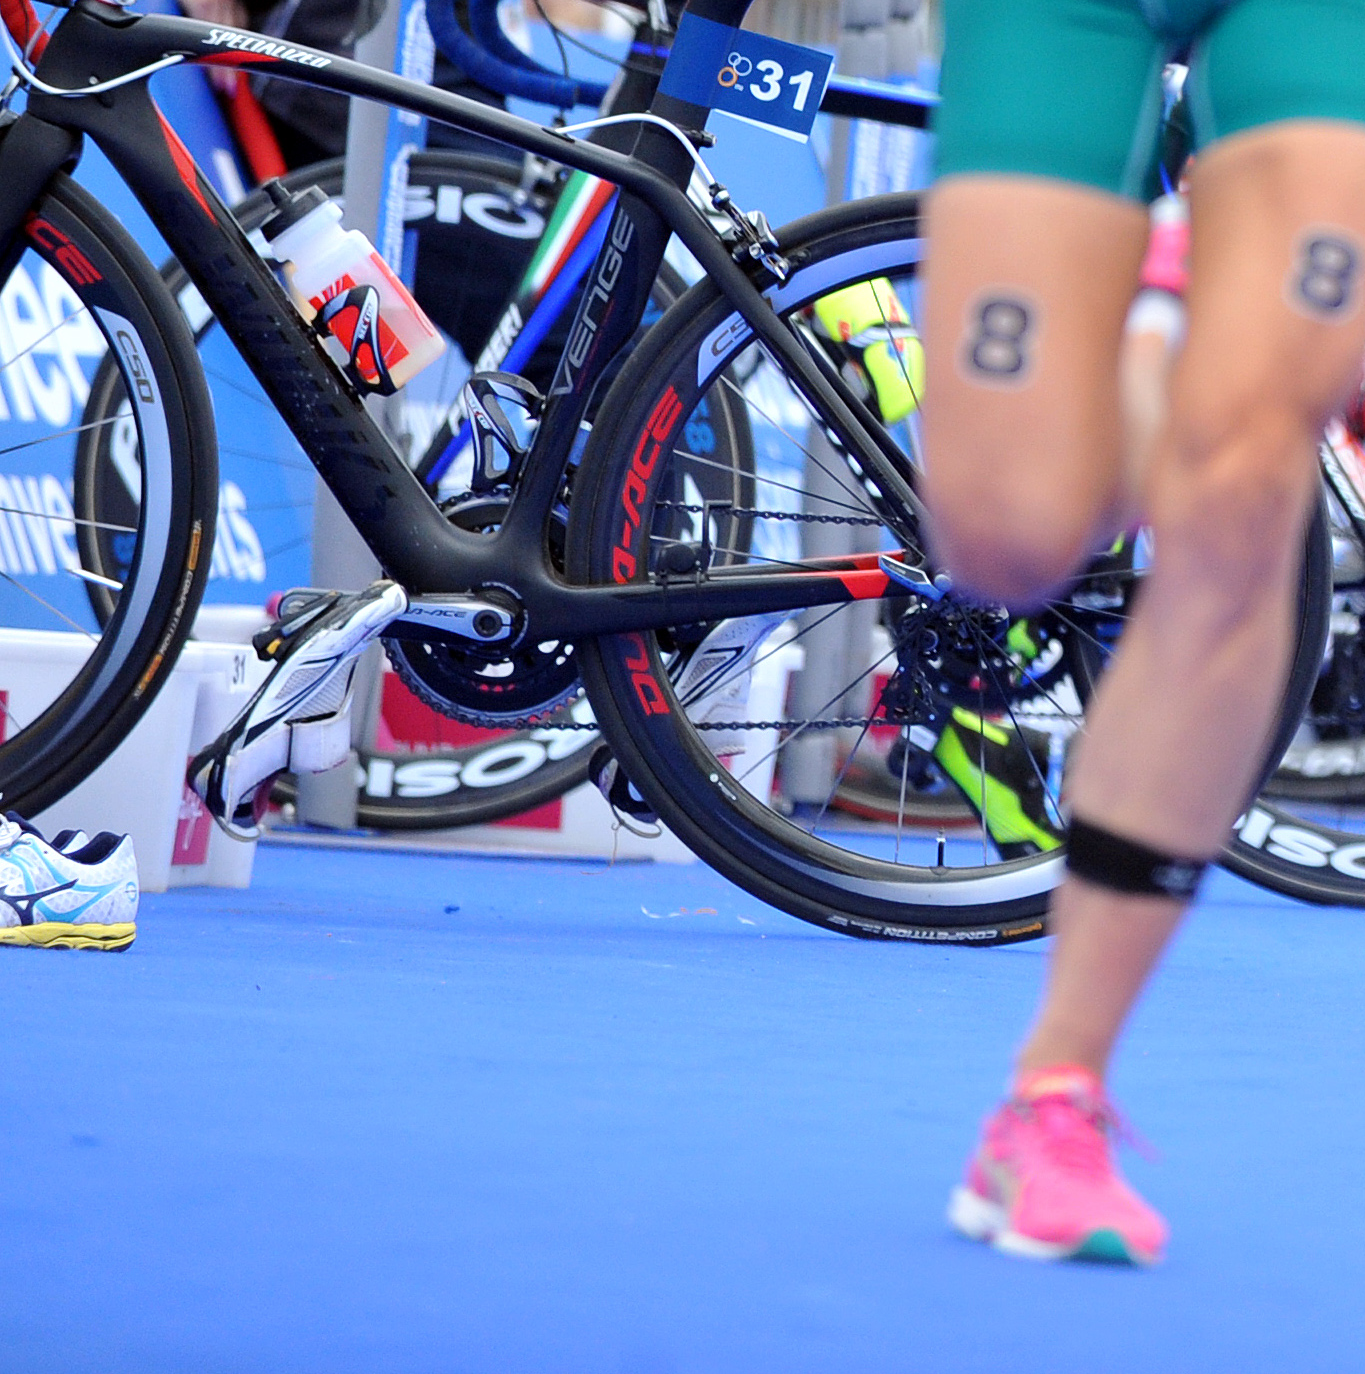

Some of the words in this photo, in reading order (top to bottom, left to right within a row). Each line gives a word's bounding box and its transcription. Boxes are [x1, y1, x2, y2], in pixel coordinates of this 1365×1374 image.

[202, 28, 332, 69] SPECIALIZED
[749, 59, 815, 112] 31
[551, 203, 634, 396] VENGE
[1296, 232, 1362, 320] 8
[116, 330, 155, 404] C50
[966, 290, 1036, 384] 8
[882, 926, 998, 942] COMPETITION
